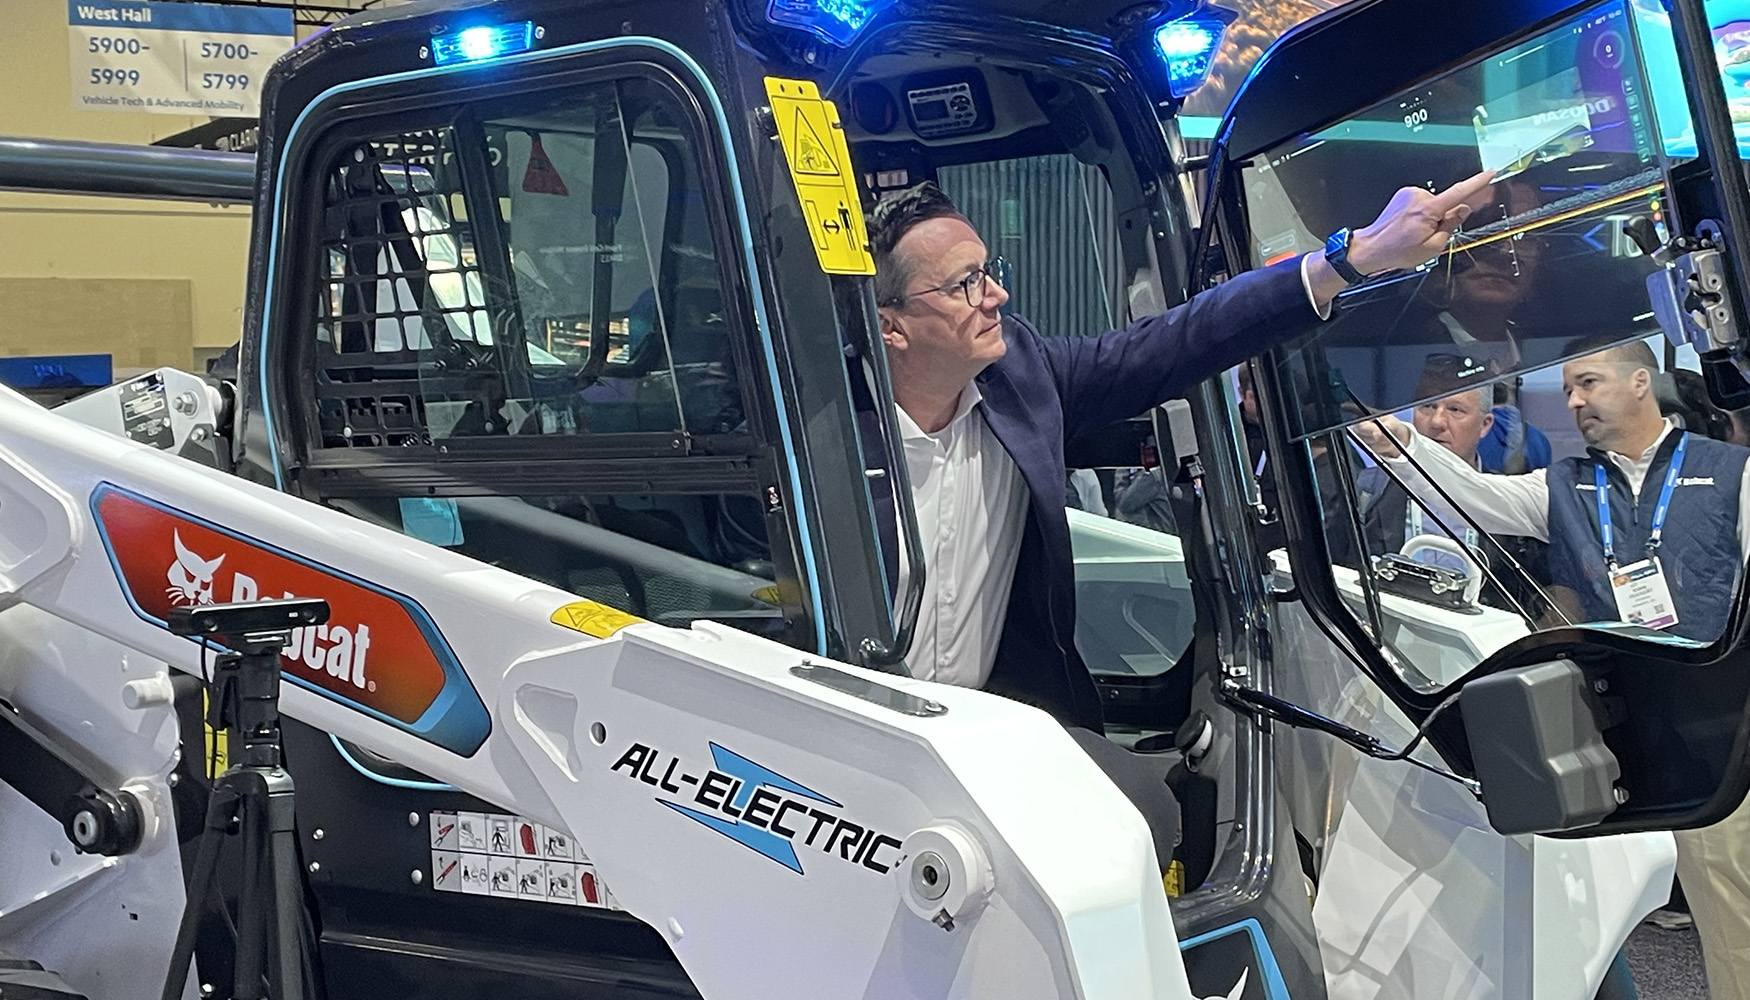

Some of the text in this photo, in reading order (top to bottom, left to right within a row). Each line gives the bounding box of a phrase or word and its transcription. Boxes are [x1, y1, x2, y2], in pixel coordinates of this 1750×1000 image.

[77, 5, 152, 22] West Hall
[88, 37, 150, 55] 5900-
[200, 42, 258, 59] 5700-
[89, 68, 140, 86] 5999
[202, 73, 249, 90] 5799
[82, 95, 119, 106] Vehicle
[121, 96, 144, 107] Tech
[155, 98, 201, 110] Advanced
[205, 100, 245, 112] Mobility
[1403, 108, 1428, 128] 900
[231, 571, 371, 690] cat
[610, 742, 903, 875] ALL-ELECTRIC
